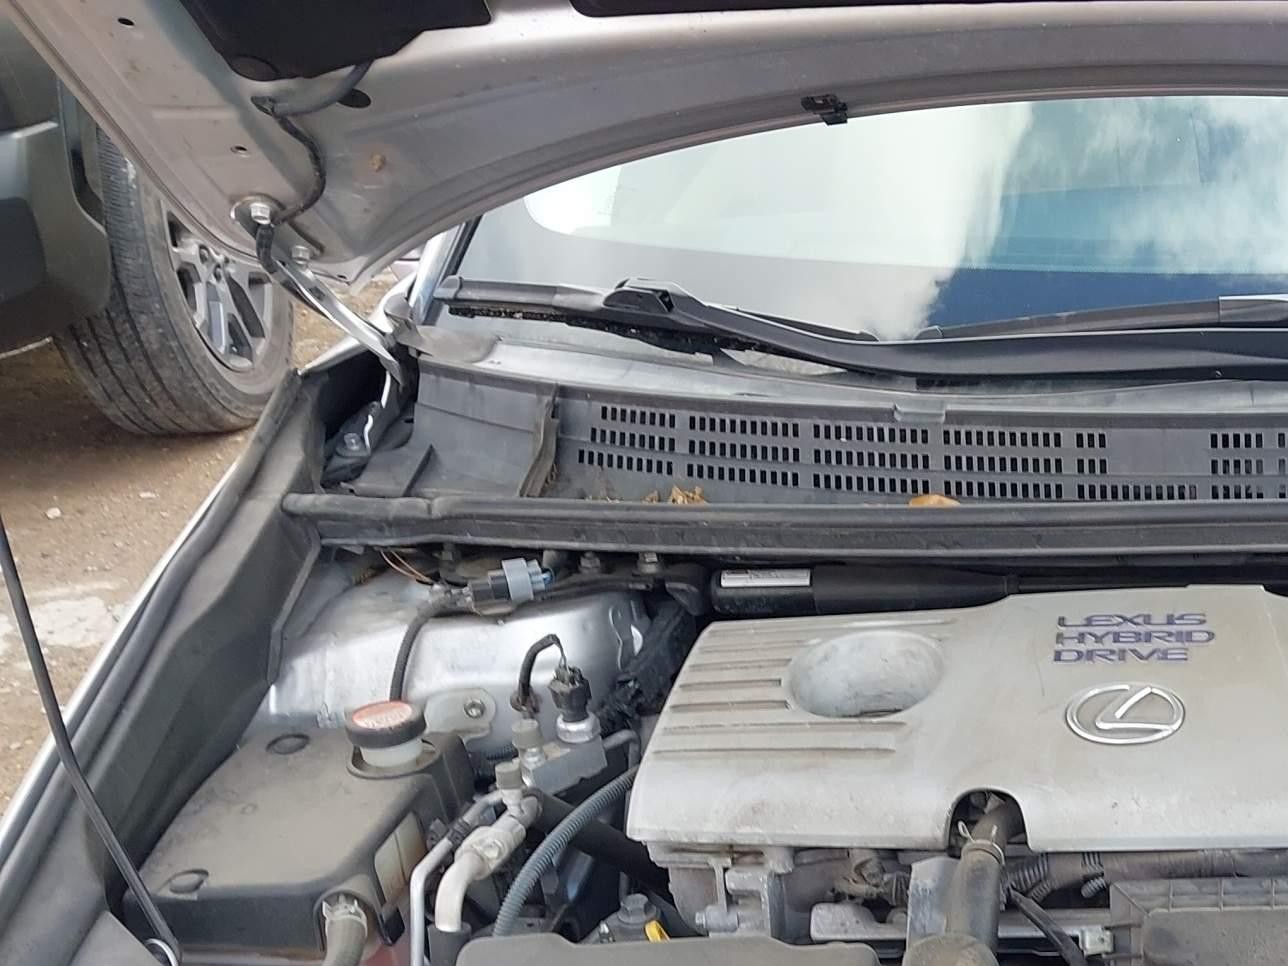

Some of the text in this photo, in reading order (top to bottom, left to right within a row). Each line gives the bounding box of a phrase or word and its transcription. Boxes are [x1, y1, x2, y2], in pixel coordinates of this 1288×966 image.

[1057, 613, 1208, 628] LEXUS
[1055, 630, 1216, 646] HYBRID
[1053, 648, 1190, 663] DRIVE
